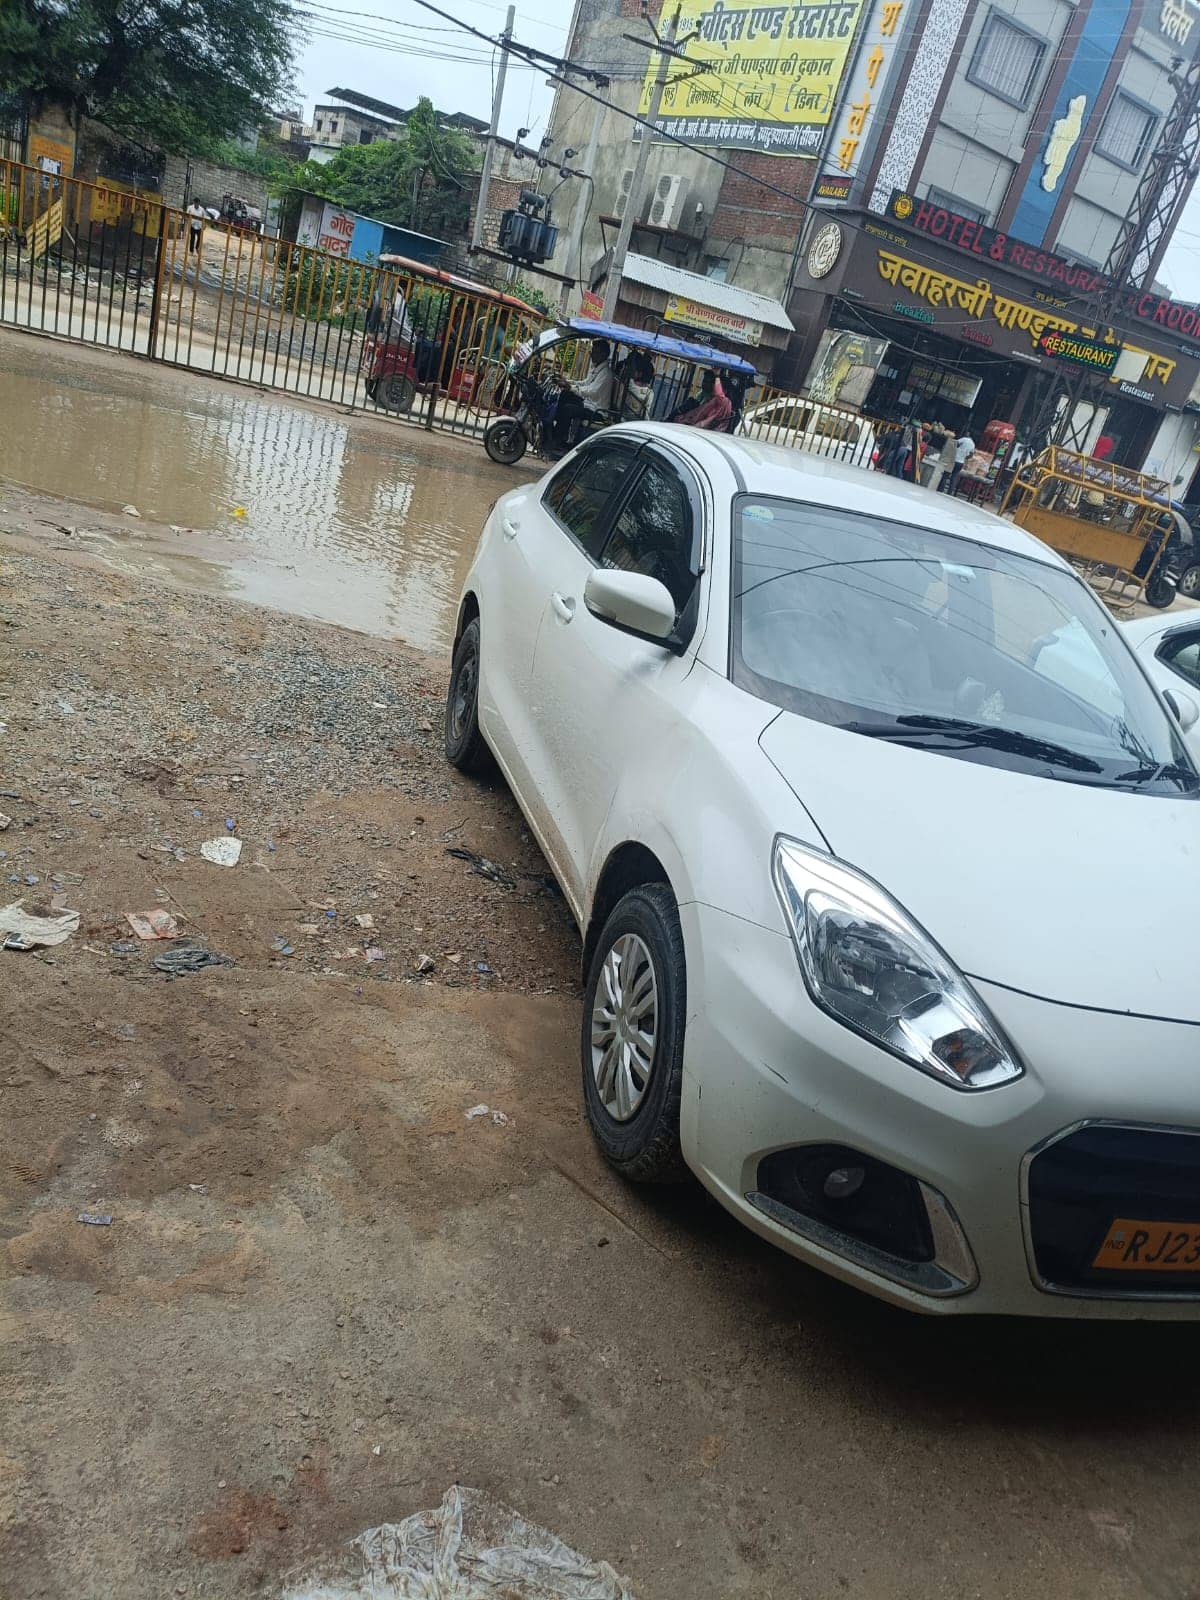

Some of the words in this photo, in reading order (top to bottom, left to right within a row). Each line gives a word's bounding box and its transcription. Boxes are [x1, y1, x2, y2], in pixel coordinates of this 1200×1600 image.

[779, 53, 799, 76] की
[794, 58, 836, 83] दुकान
[793, 87, 823, 110] डिनर
[817, 184, 849, 198] AVAILABLE
[914, 202, 985, 255] HOTEL
[989, 235, 1007, 261] &
[1010, 245, 1106, 294] RESTAURA
[1045, 334, 1115, 367] RESTAURANT
[1119, 381, 1155, 402] Restaurant
